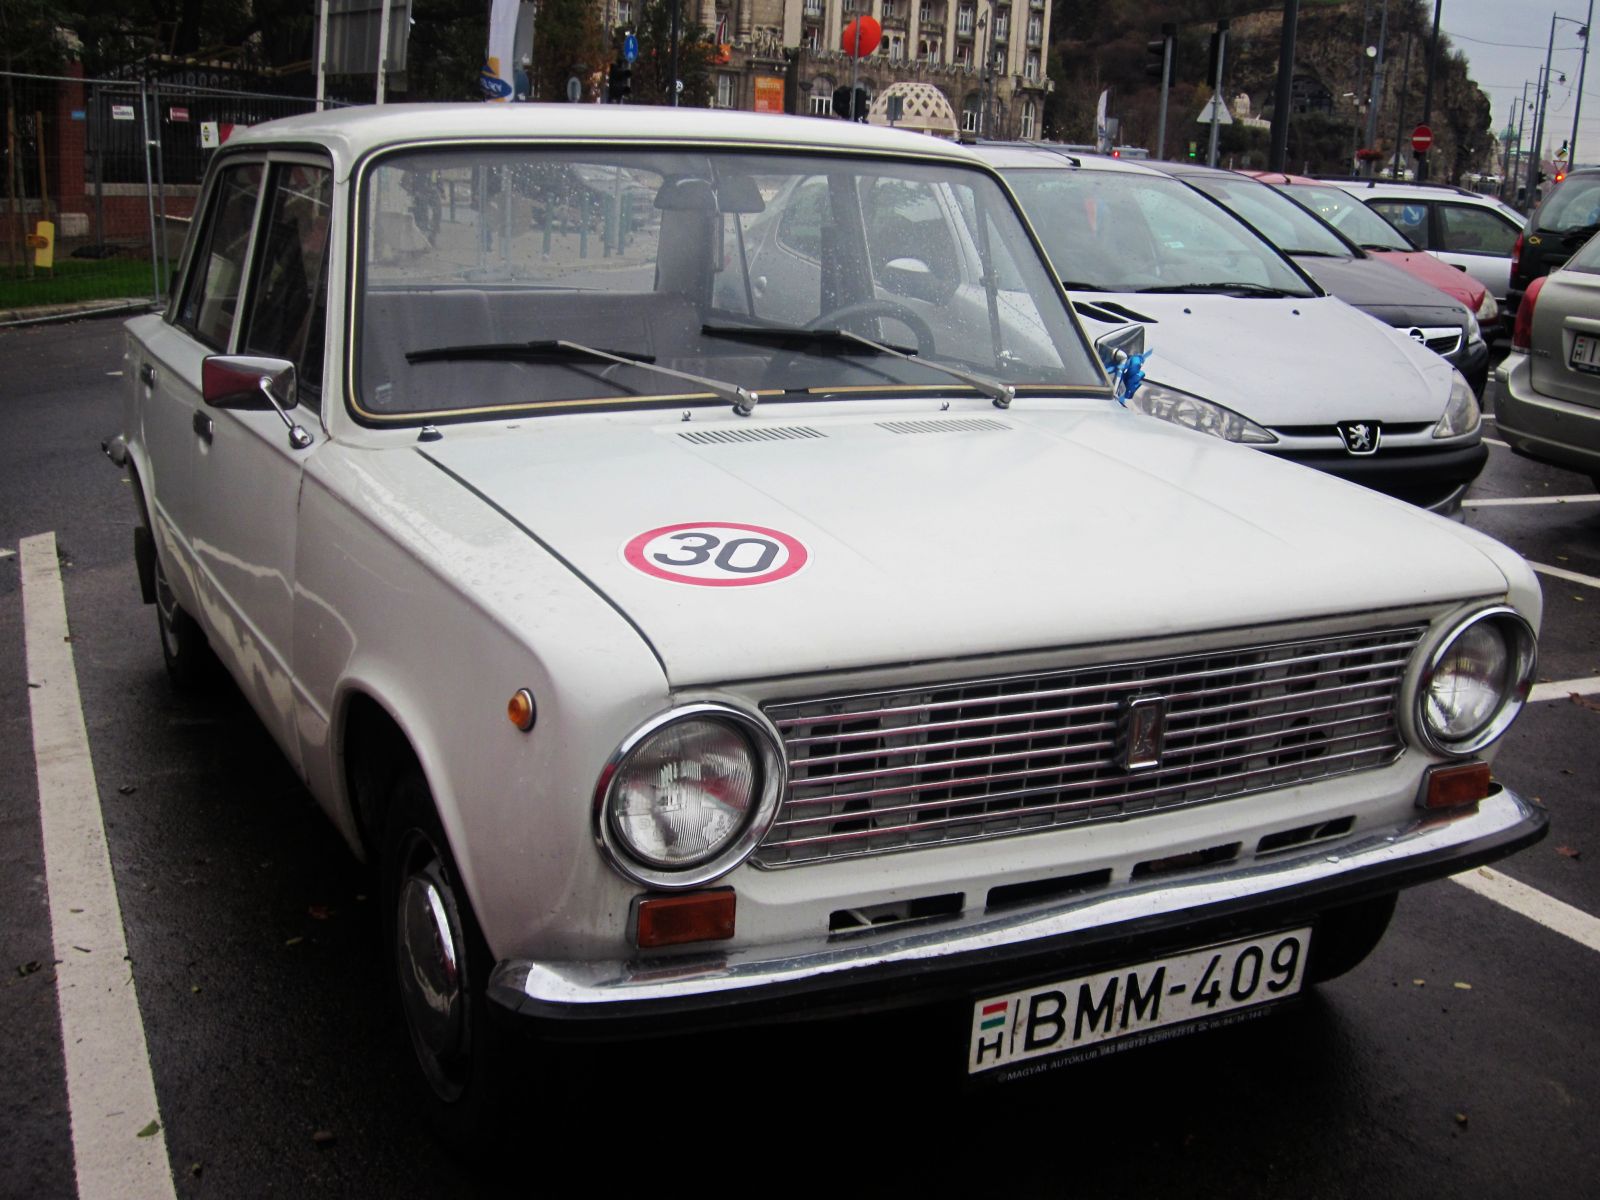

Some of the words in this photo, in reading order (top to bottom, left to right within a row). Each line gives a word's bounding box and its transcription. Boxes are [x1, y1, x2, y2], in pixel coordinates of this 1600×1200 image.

[653, 532, 780, 574] 30
[976, 1031, 1003, 1065] H
[1023, 936, 1302, 1053] BMM-409
[1007, 1063, 1047, 1081] MAGYAR
